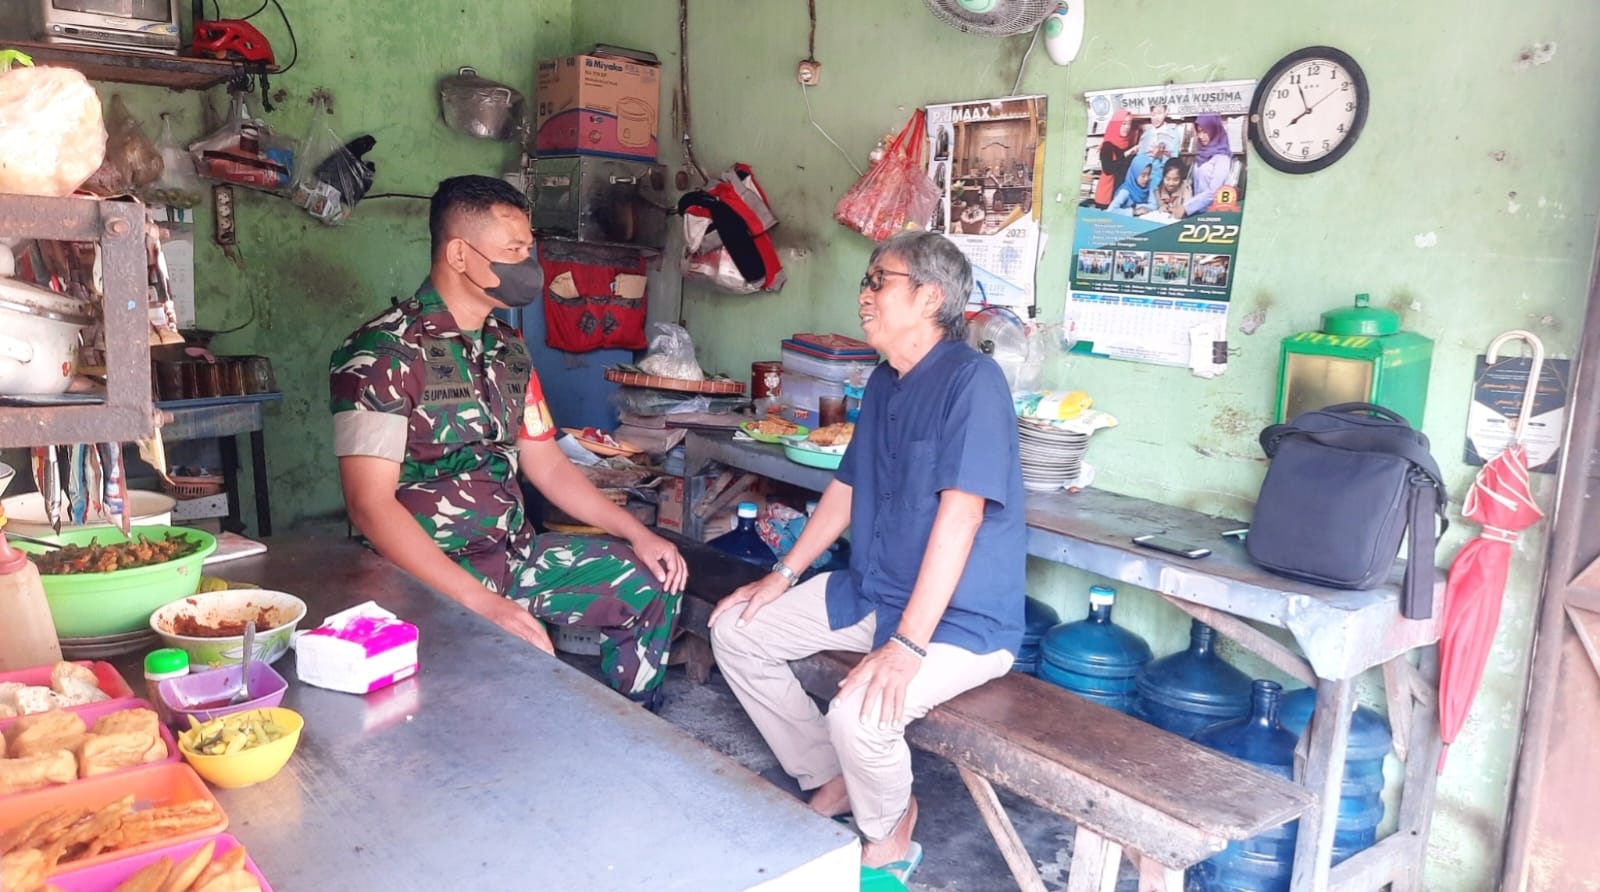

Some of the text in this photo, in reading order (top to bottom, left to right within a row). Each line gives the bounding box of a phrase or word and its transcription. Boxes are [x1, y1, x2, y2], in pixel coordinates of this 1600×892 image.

[594, 60, 623, 72] Miyako
[1307, 66, 1320, 76] 12
[1289, 74, 1301, 84] 11
[1330, 70, 1336, 79] 1
[1341, 82, 1349, 91] 2
[1122, 91, 1242, 107] SMK WIJAYA KUSUMA
[1276, 89, 1289, 99] 10
[1345, 102, 1353, 112] 3
[934, 106, 991, 123] PRIMAAX
[1268, 110, 1276, 119] 9
[1272, 129, 1280, 138] 8
[1337, 124, 1344, 133] 4
[1285, 142, 1293, 151] 7
[1322, 139, 1330, 149] 5
[1302, 146, 1310, 156] 6
[1221, 191, 1230, 202] B
[1006, 228, 1026, 238] 2023
[1178, 224, 1239, 243] 2022
